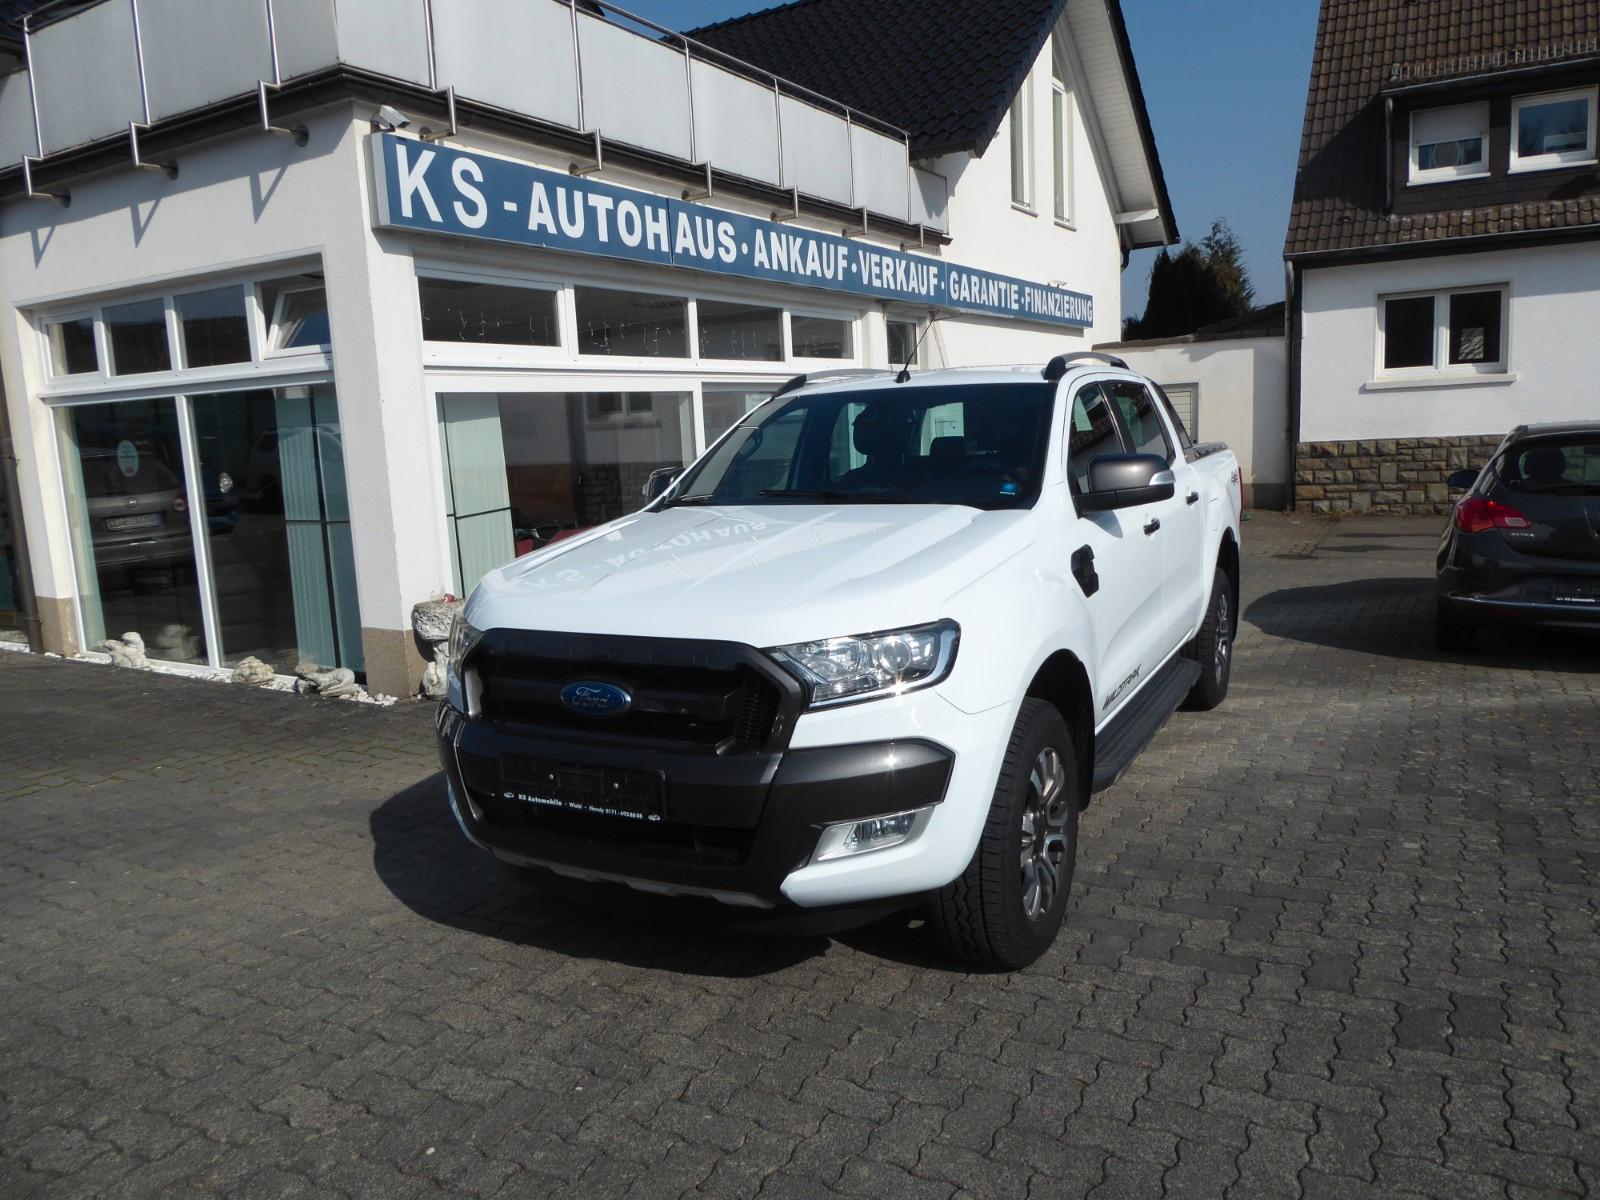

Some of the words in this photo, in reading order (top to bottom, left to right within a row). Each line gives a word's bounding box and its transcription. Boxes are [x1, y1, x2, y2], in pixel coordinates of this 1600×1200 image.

[395, 143, 488, 229] KS
[528, 181, 738, 264] AUTOHAUS
[753, 228, 849, 281] ANKAUF
[858, 250, 939, 297] VERKAUF
[949, 270, 1020, 311] GARANTIE
[1024, 287, 1094, 323] FINANZIERUNG
